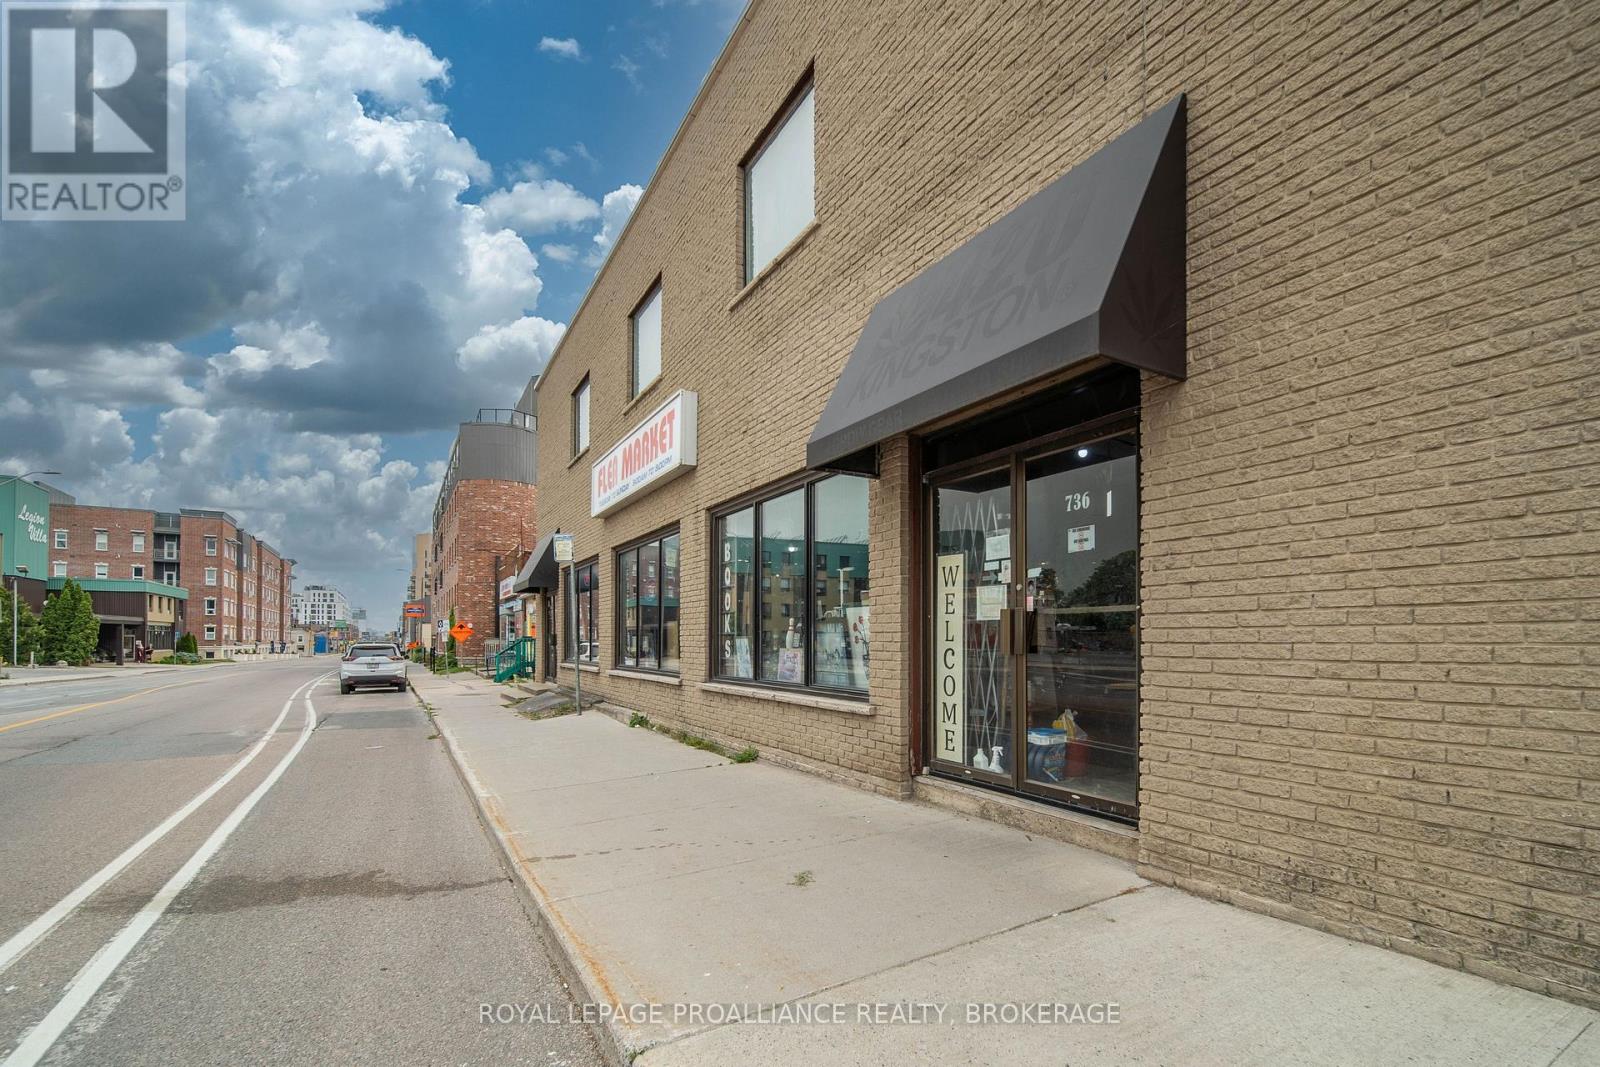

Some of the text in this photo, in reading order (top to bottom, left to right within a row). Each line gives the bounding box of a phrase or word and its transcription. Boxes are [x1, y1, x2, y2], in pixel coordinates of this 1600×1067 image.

[598, 408, 675, 498] FLEA MARKET
[1065, 491, 1091, 512] 736
[17, 504, 45, 530] Legion
[28, 523, 47, 544] Villa
[942, 565, 960, 752] WELCOME
